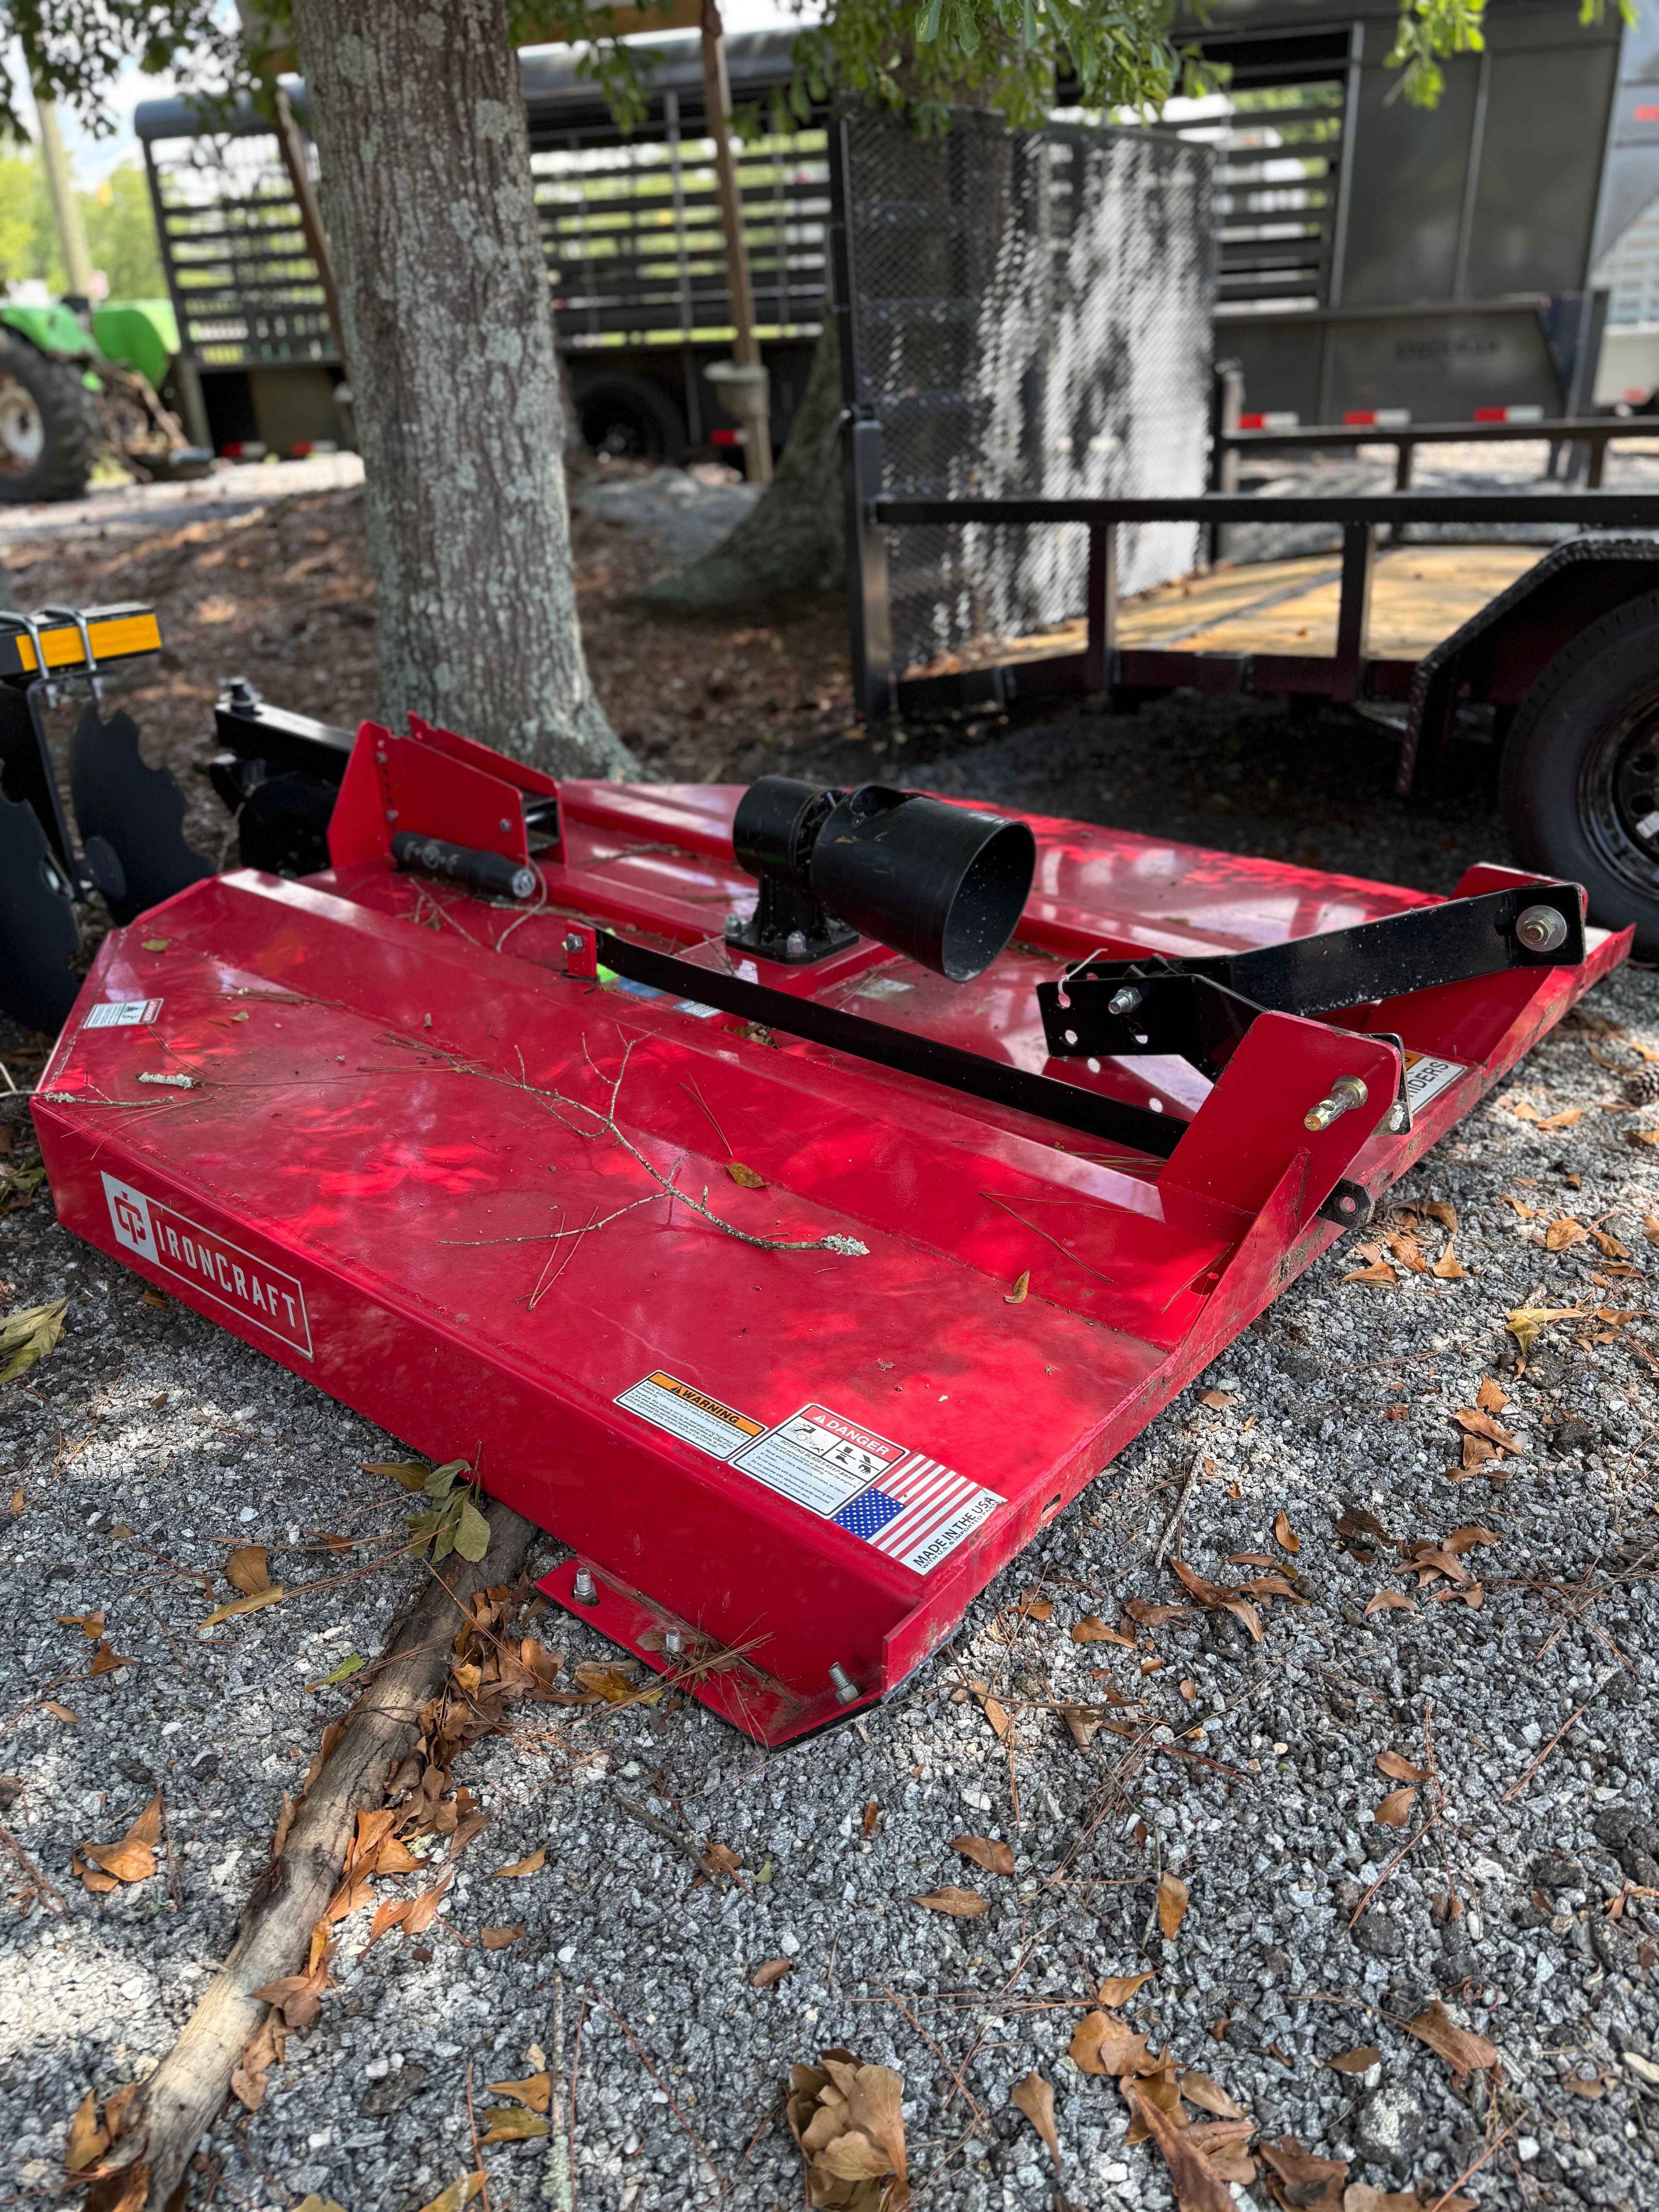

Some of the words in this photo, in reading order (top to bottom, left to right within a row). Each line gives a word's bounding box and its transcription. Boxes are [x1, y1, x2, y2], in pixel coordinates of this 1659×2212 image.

[143, 1003, 157, 1022] DANGER
[155, 1220, 296, 1328] IRONCRAFT
[624, 1396, 637, 1405] factory
[636, 1404, 654, 1413] approved
[640, 1401, 656, 1410] enclosed
[658, 1412, 678, 1423] permanent
[682, 1389, 740, 1424] WARNING
[682, 1420, 697, 1429] present
[689, 1420, 706, 1429] operated
[715, 1434, 733, 1444] highways
[691, 1411, 705, 1419] serious
[719, 1425, 740, 1438] bystanders
[722, 1423, 736, 1431] objects
[766, 1442, 780, 1451] running
[825, 1420, 890, 1455] DANGER
[780, 1440, 805, 1454] ROTATING
[804, 1453, 841, 1472] BLADES-KEEP
[838, 1472, 855, 1480] AWAY
[787, 1449, 800, 1458] serious
[763, 1466, 776, 1474] operate
[768, 1462, 781, 1470] operate
[788, 1474, 808, 1486] bystanders
[811, 1487, 826, 1496] mowing
[796, 1466, 814, 1477] especially
[912, 1539, 947, 1566] MADE
[941, 1528, 958, 1541] IN
[951, 1513, 976, 1530] THE
[971, 1497, 996, 1514] USA
[921, 1555, 938, 1568] WITH
[937, 1546, 950, 1555] U.S.
[953, 1516, 982, 1540] IMPORTED
